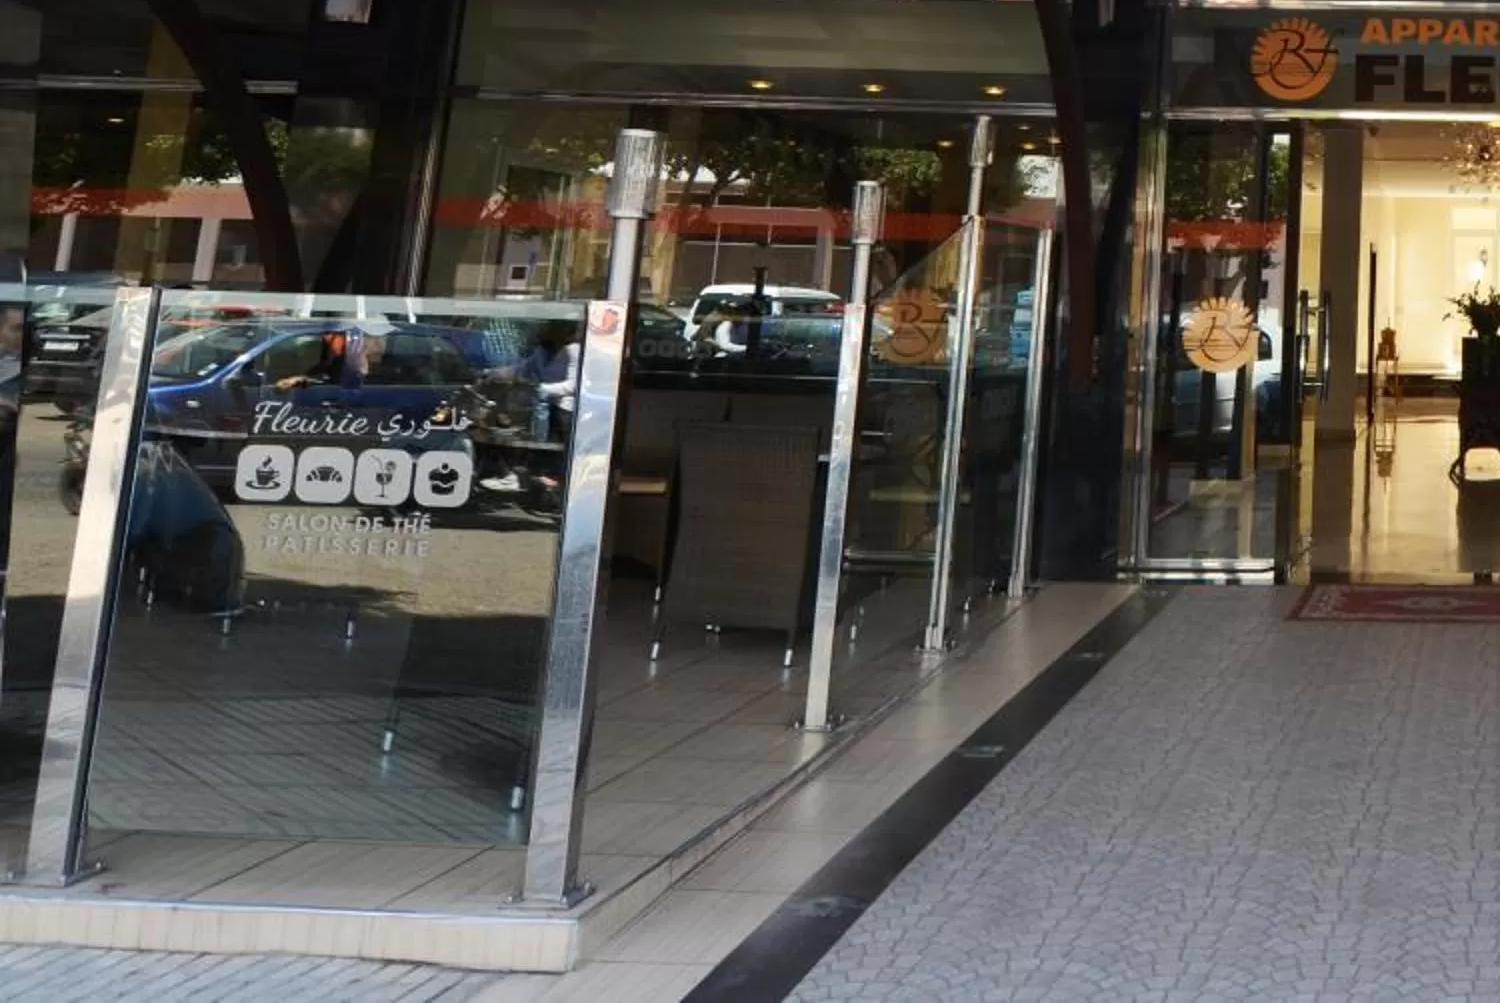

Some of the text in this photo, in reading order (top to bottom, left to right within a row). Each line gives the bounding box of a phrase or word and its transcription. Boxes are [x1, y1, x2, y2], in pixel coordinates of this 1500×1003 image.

[252, 401, 369, 435] Fleurie
[267, 512, 346, 532] SALON
[355, 516, 384, 534] DE
[263, 535, 429, 558] PATISSERIE
